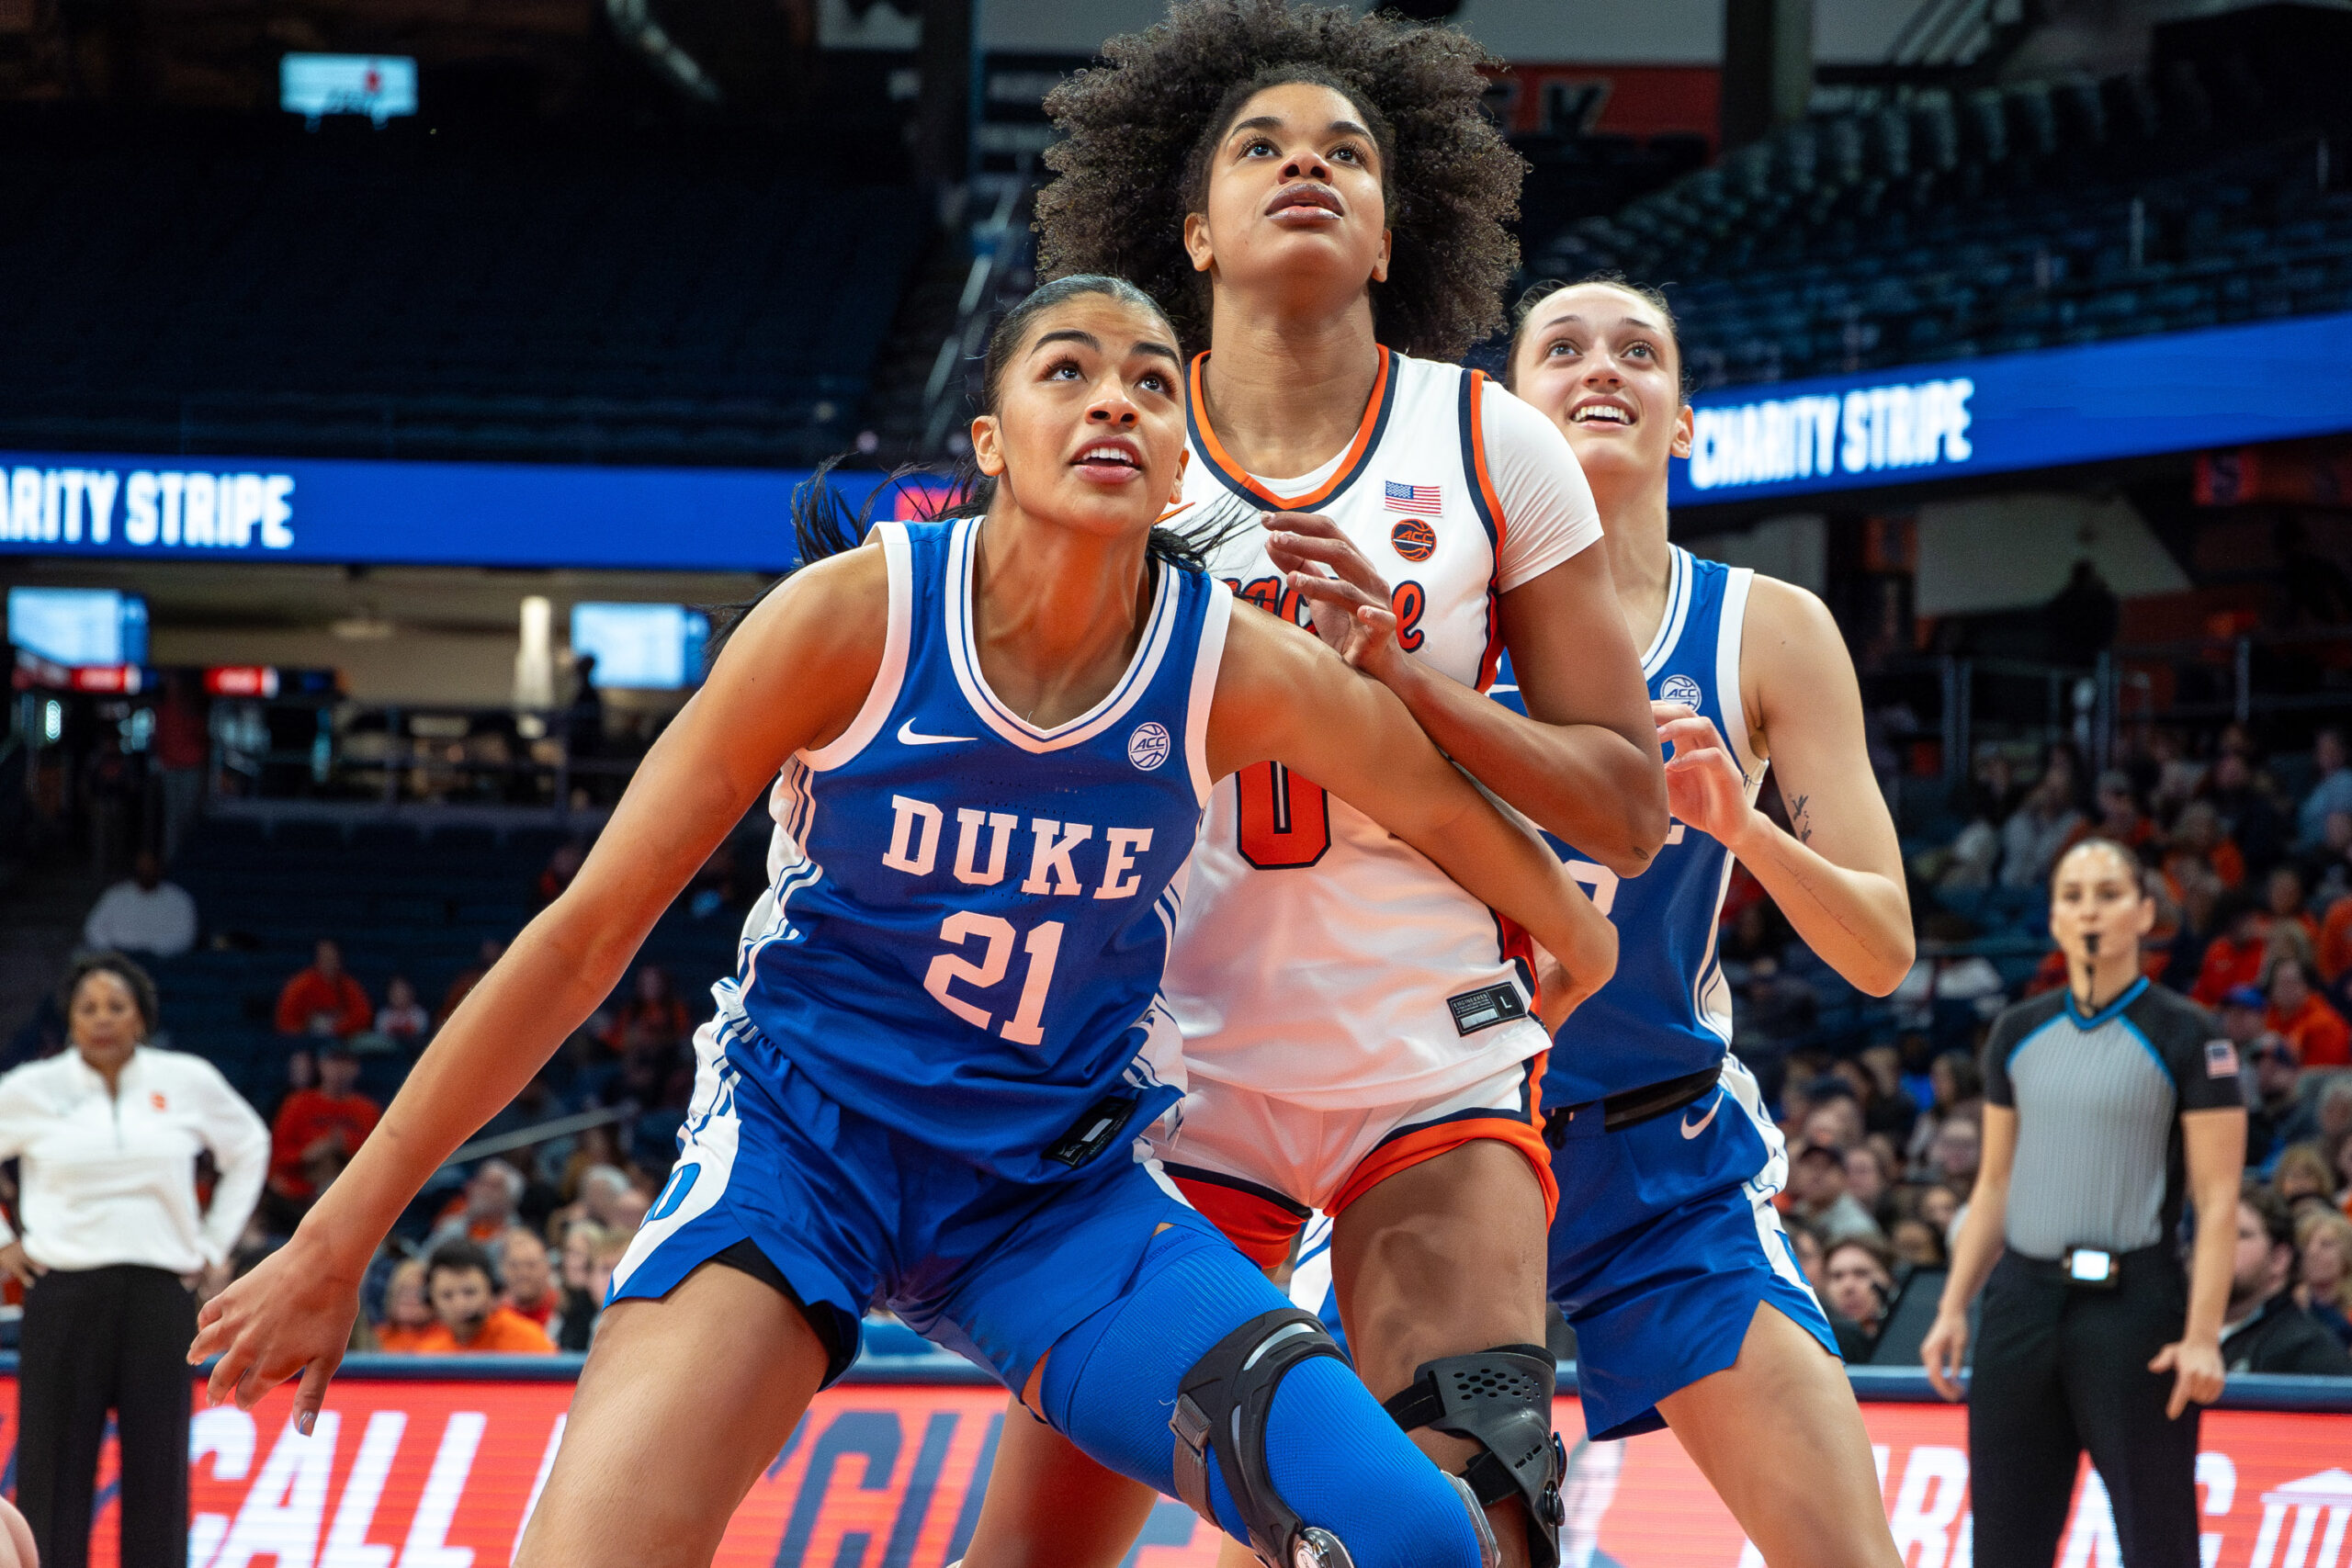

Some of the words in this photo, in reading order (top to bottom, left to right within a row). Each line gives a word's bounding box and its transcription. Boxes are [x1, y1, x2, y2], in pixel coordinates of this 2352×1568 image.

[1690, 394, 1841, 490] CHARITY
[1840, 378, 1974, 474] STRIPE
[0, 465, 119, 545] RITY
[124, 469, 296, 549] STRIPE
[1396, 530, 1434, 544] ACC
[1666, 688, 1698, 698] ACC
[1133, 736, 1168, 750] ACC
[882, 795, 1154, 899] DUKE
[923, 910, 1064, 1045] 21
[1499, 996, 1512, 1009] L
[188, 1405, 487, 1568] CALL
